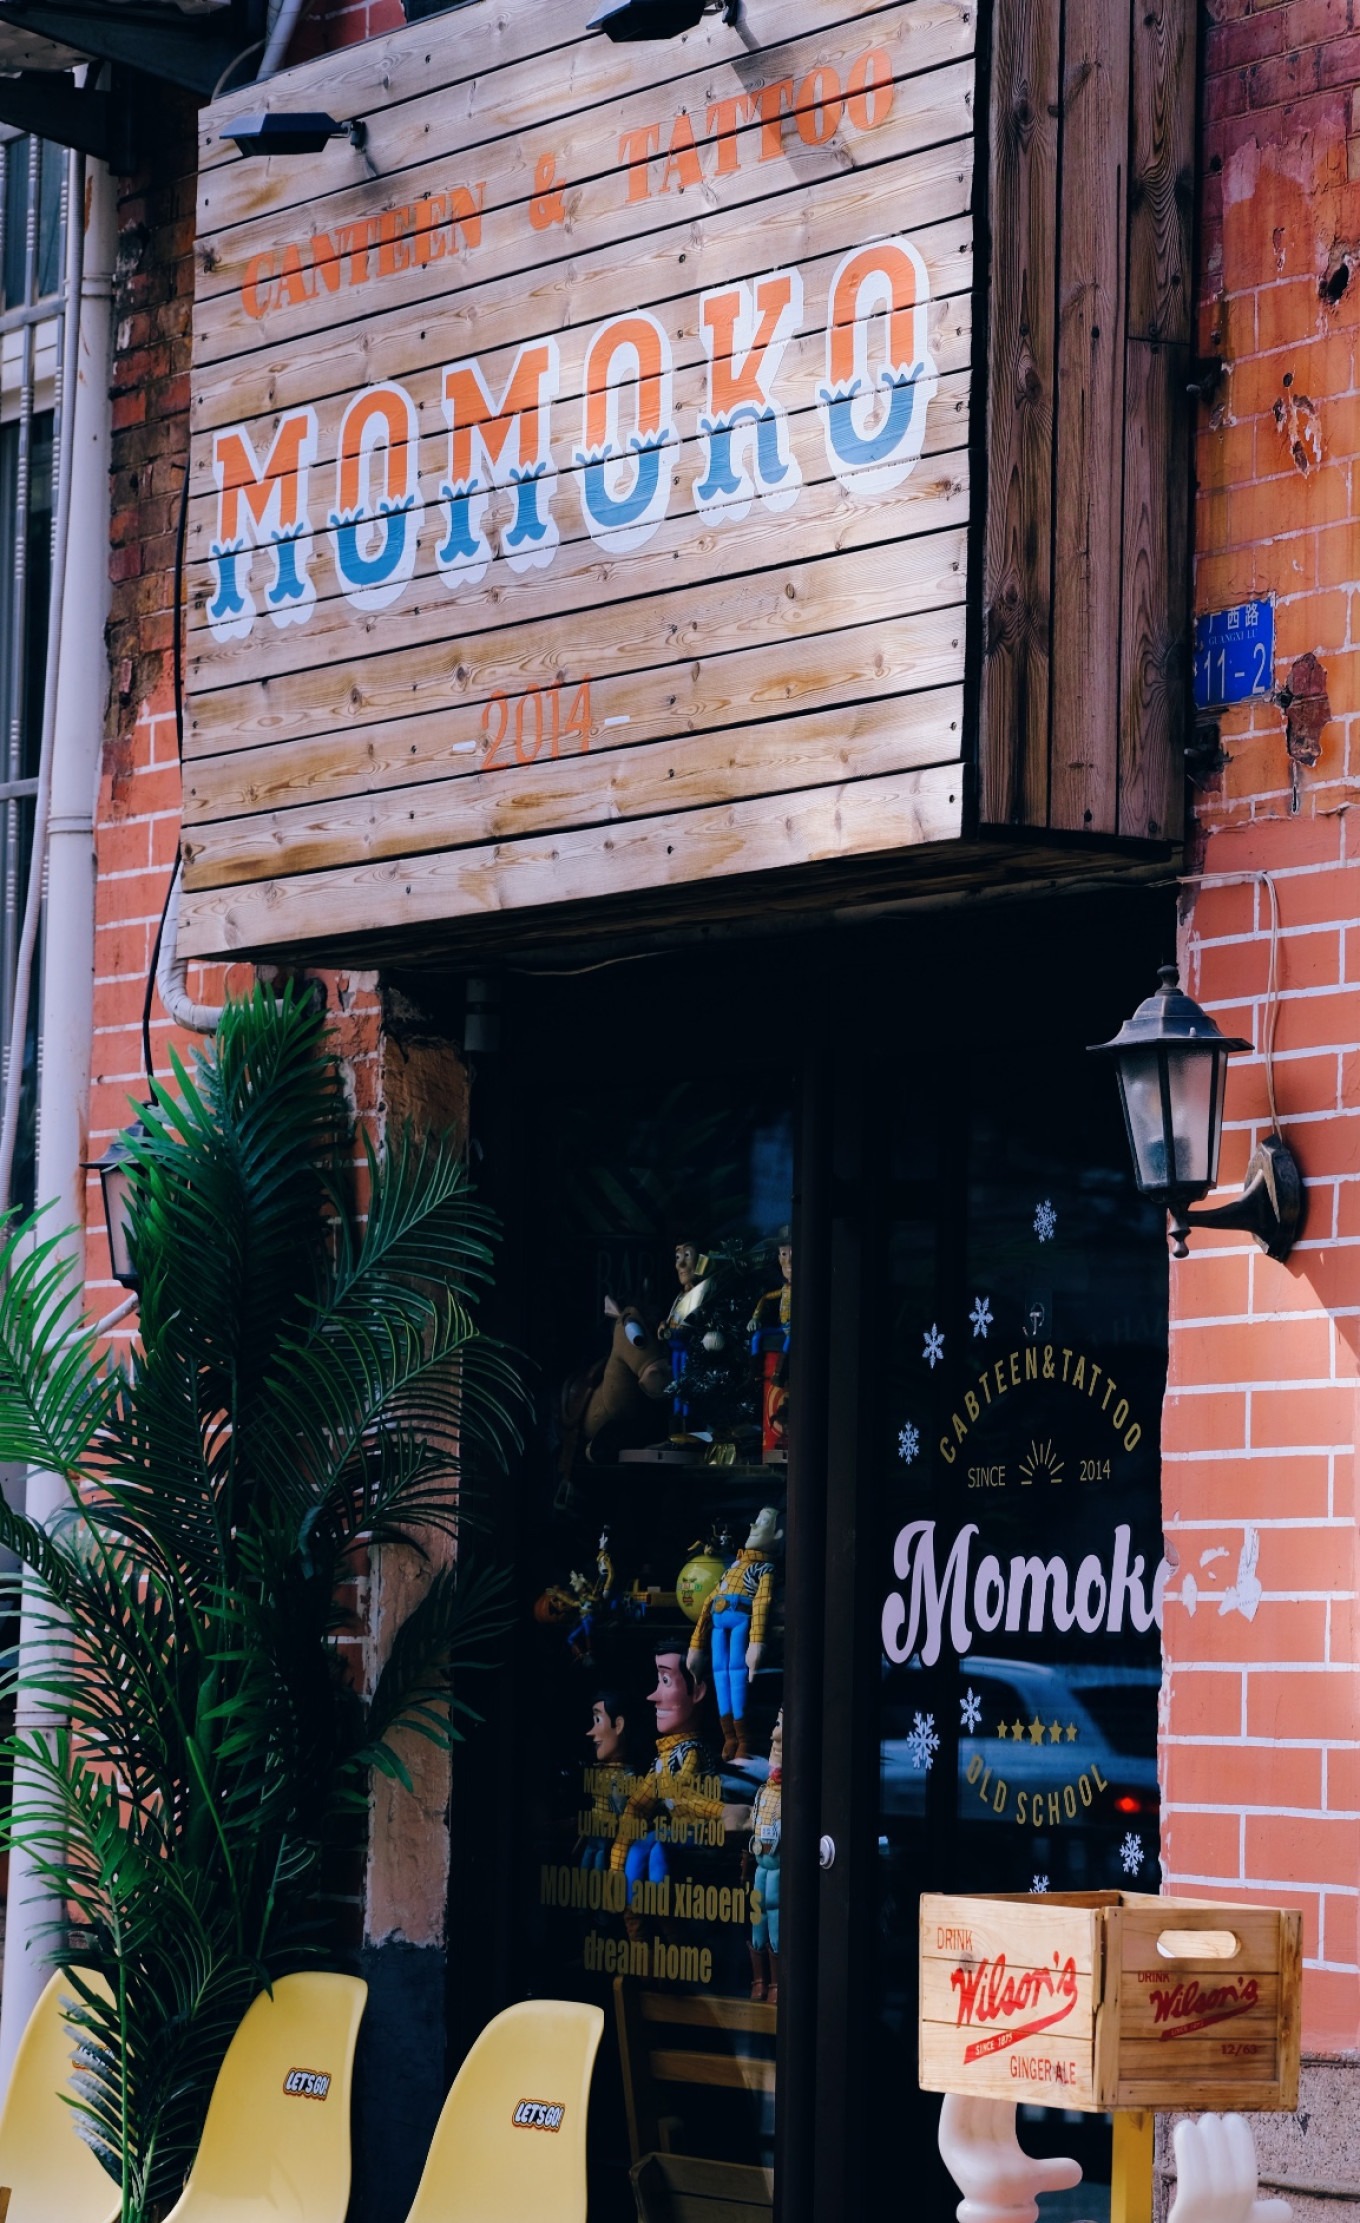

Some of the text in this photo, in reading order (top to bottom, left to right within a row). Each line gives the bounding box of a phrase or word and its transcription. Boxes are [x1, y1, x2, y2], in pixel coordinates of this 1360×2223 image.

[240, 47, 893, 320] CANTEEN & TATTOO
[209, 238, 934, 635] MOMOKO
[1209, 602, 1259, 633] 广西路
[1204, 642, 1266, 701] 11-2
[481, 672, 593, 773] 2014
[940, 1345, 1142, 1464] CABTEEN&TATTOO
[967, 1459, 1111, 1488] SINCE 2014
[966, 1754, 1109, 1827] OLD SCHOOL
[654, 1815, 725, 1847] 15:00-17:00
[541, 1864, 763, 1925] MOMOKO and xiaoen's
[584, 1930, 713, 1984] dream home
[937, 1927, 973, 1951] DRINK
[950, 1950, 1078, 2029] Wilson's
[1149, 1976, 1258, 2024] Wilson's
[975, 2040, 995, 2056] SINCE
[1010, 2055, 1077, 2085] GINGER ALE
